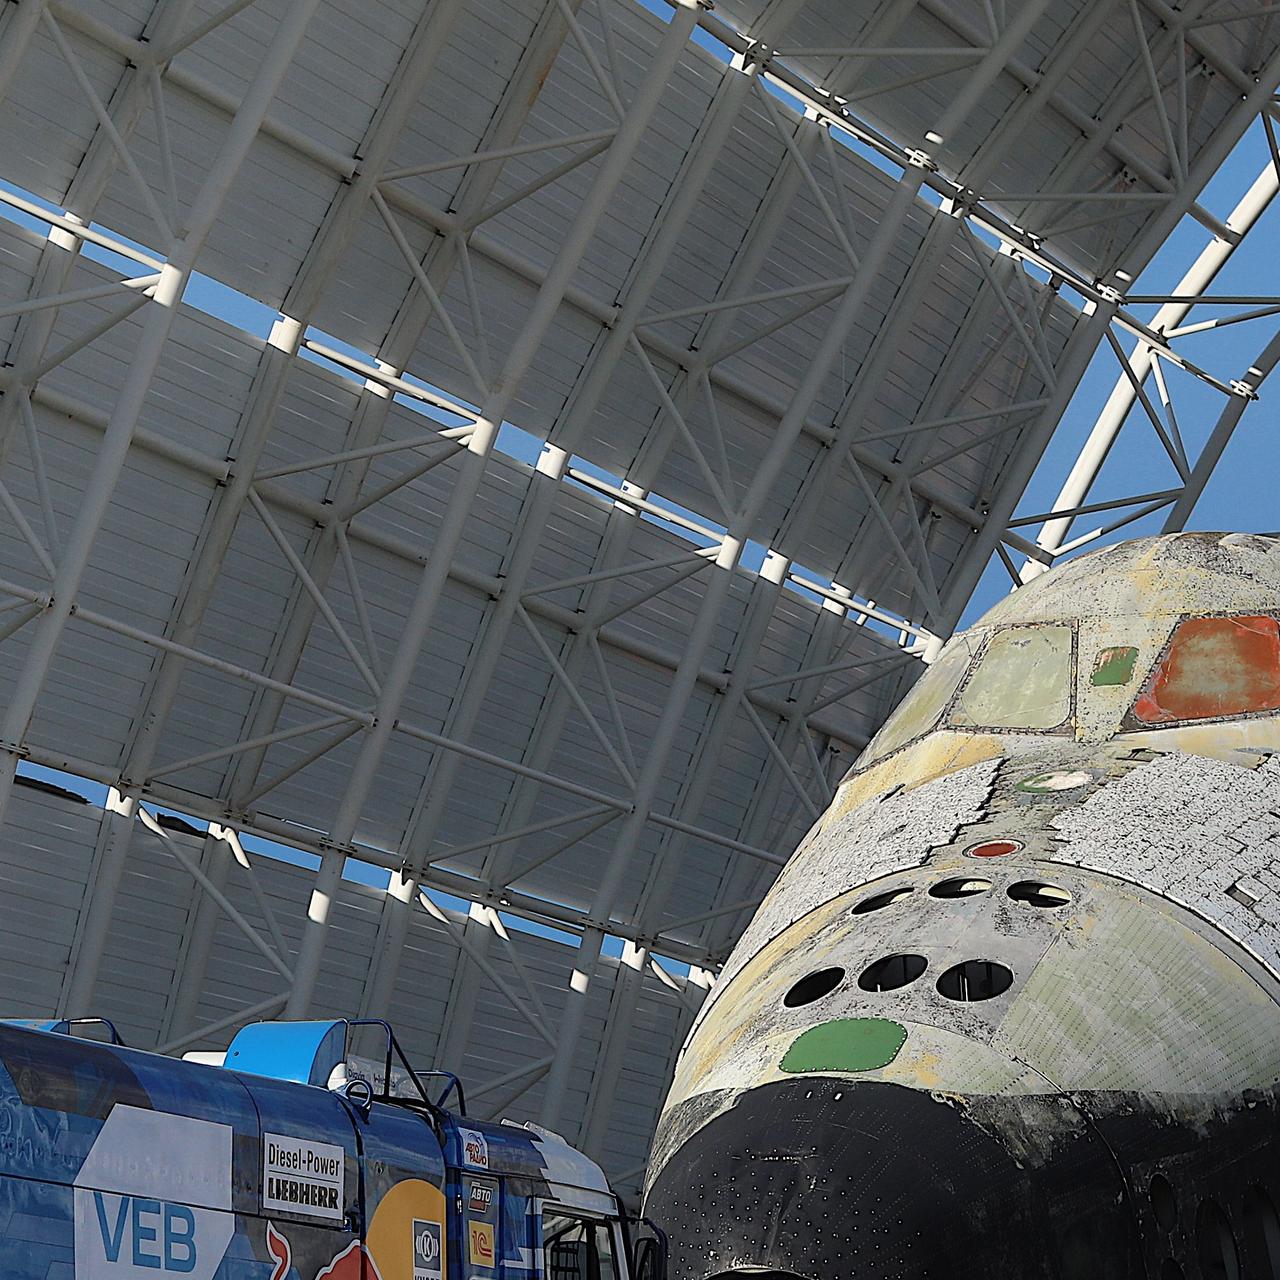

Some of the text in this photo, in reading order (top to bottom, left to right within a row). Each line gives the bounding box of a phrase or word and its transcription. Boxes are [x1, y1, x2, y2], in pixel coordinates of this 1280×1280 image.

[268, 1143, 340, 1177] Diesel-Power
[268, 1177, 339, 1210] LIEBHERR
[471, 1187, 491, 1203] АВТО
[93, 1191, 198, 1274] VEB
